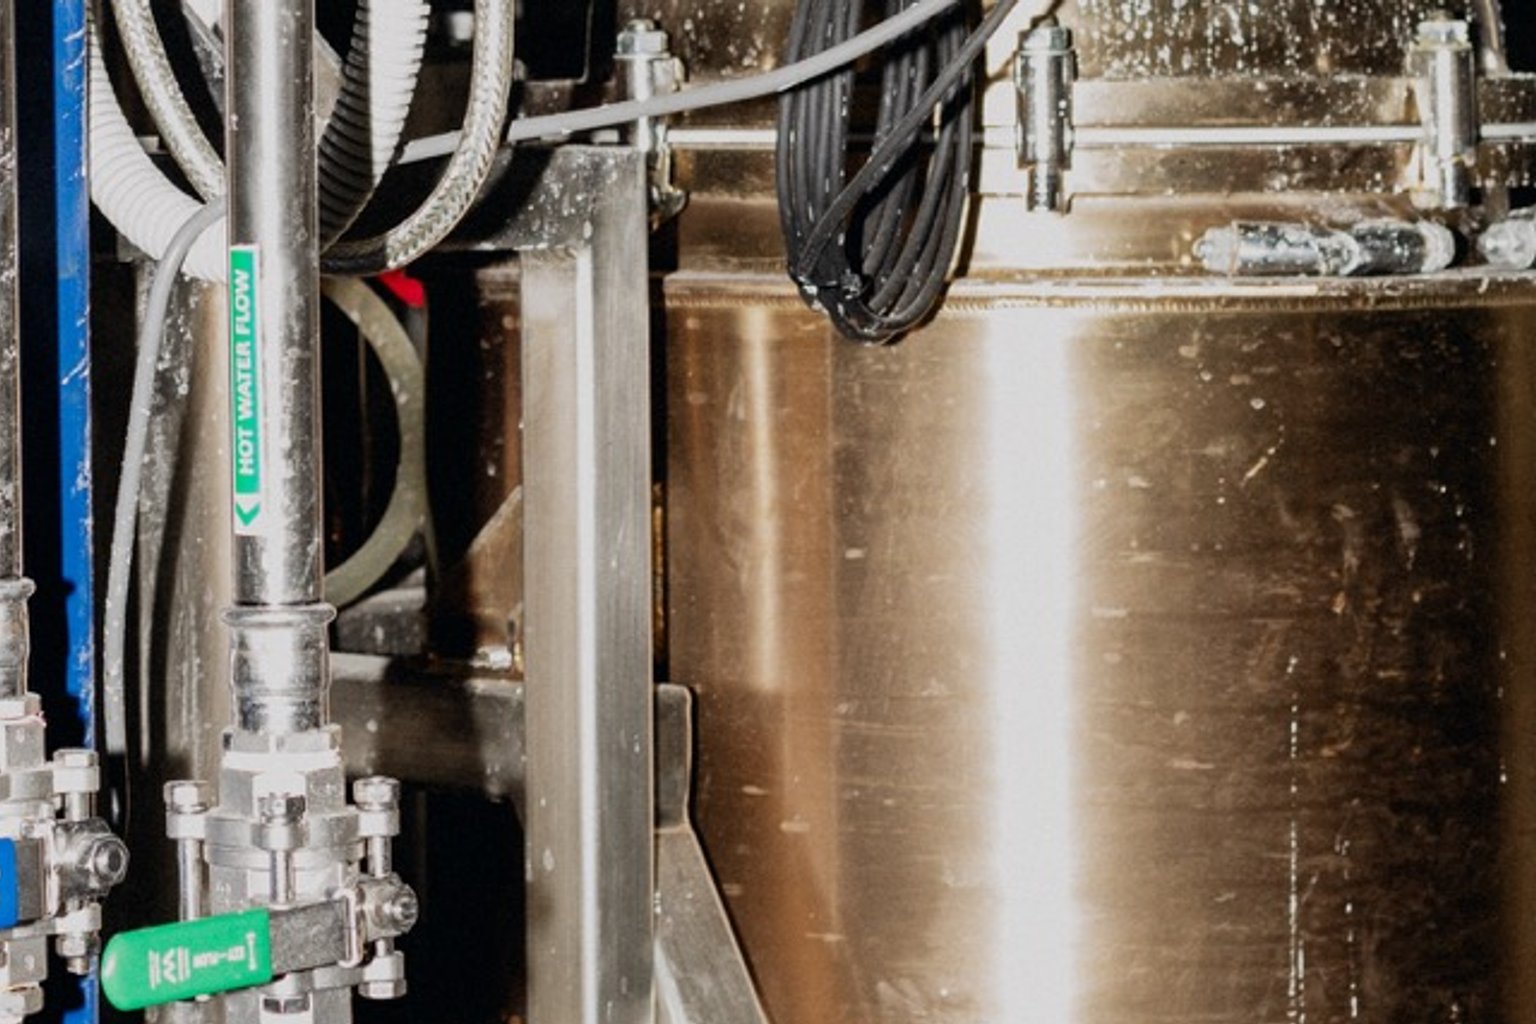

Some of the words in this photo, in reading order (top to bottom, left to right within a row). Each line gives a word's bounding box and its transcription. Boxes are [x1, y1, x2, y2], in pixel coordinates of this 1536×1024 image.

[234, 269, 251, 336] FLOW
[236, 341, 253, 421] WATER
[237, 427, 255, 477] HOT
